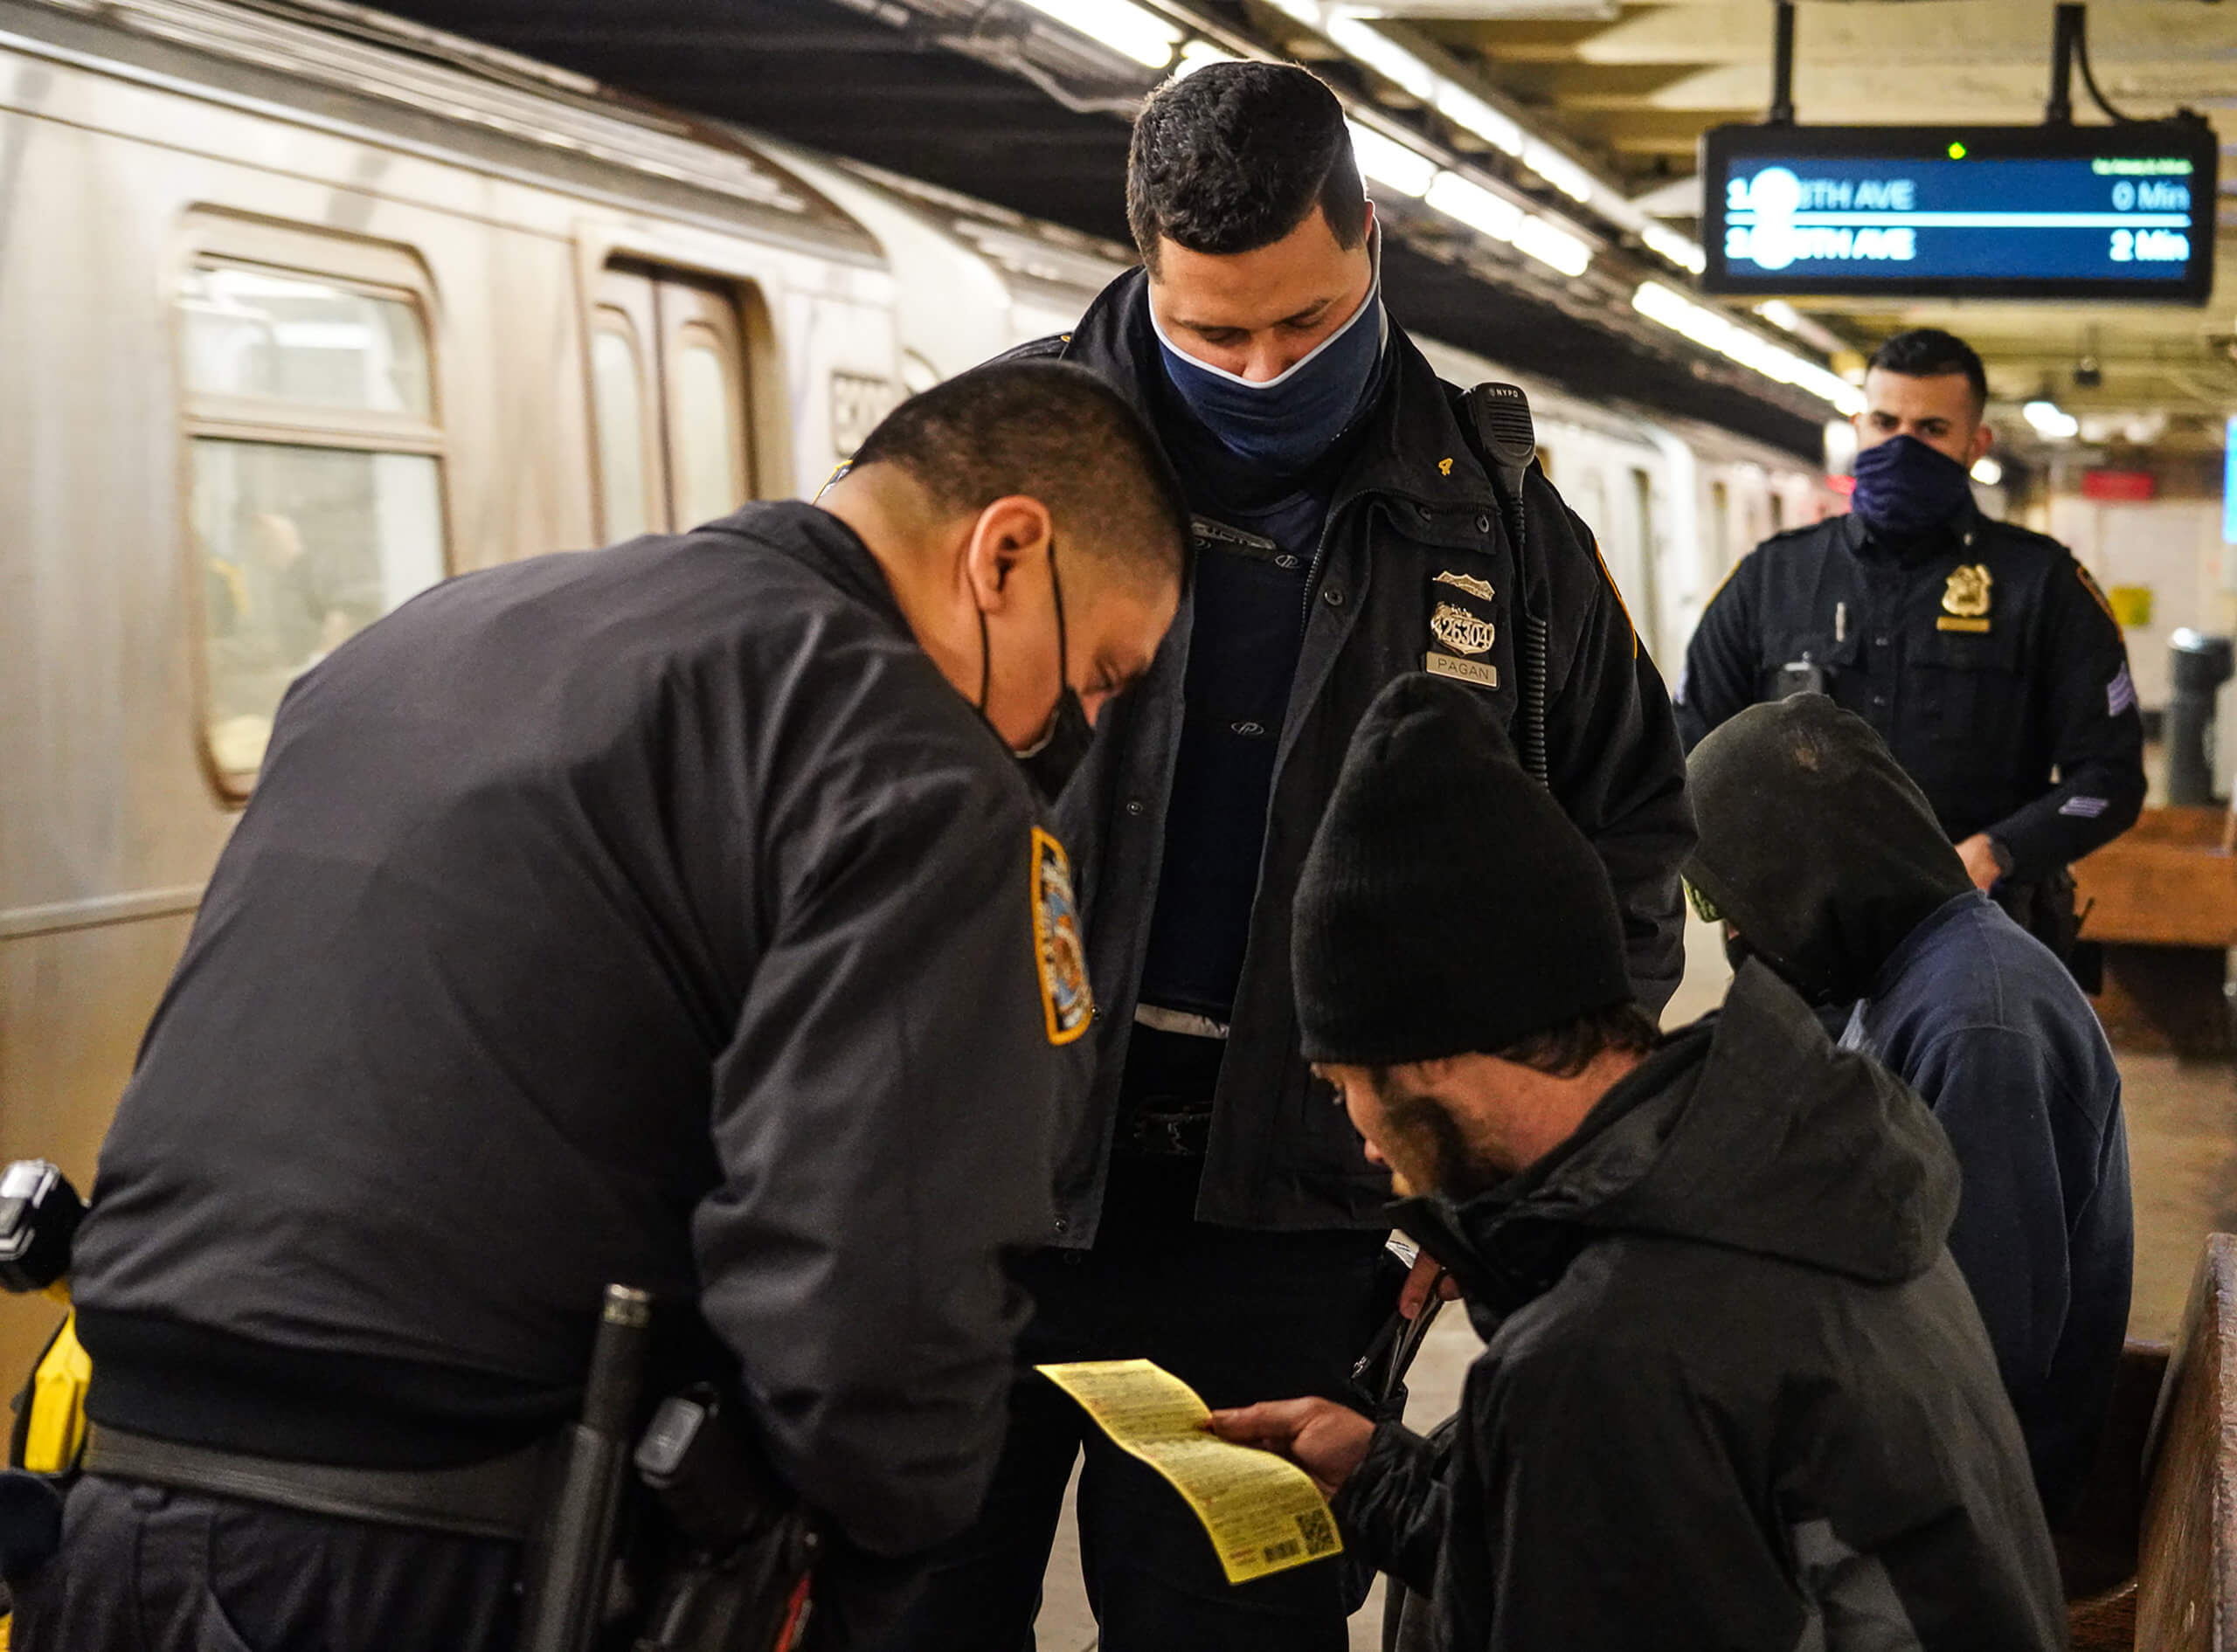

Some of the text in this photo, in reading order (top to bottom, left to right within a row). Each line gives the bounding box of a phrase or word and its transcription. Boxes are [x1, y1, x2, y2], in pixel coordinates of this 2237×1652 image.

[1854, 179, 1915, 210] AVE
[2137, 180, 2191, 211] Min
[2109, 228, 2134, 262] 2
[2135, 228, 2190, 262] Min
[1496, 388, 1519, 398] NYPD
[1440, 617, 1491, 648] 26304
[1437, 657, 1489, 680] PAGAN
